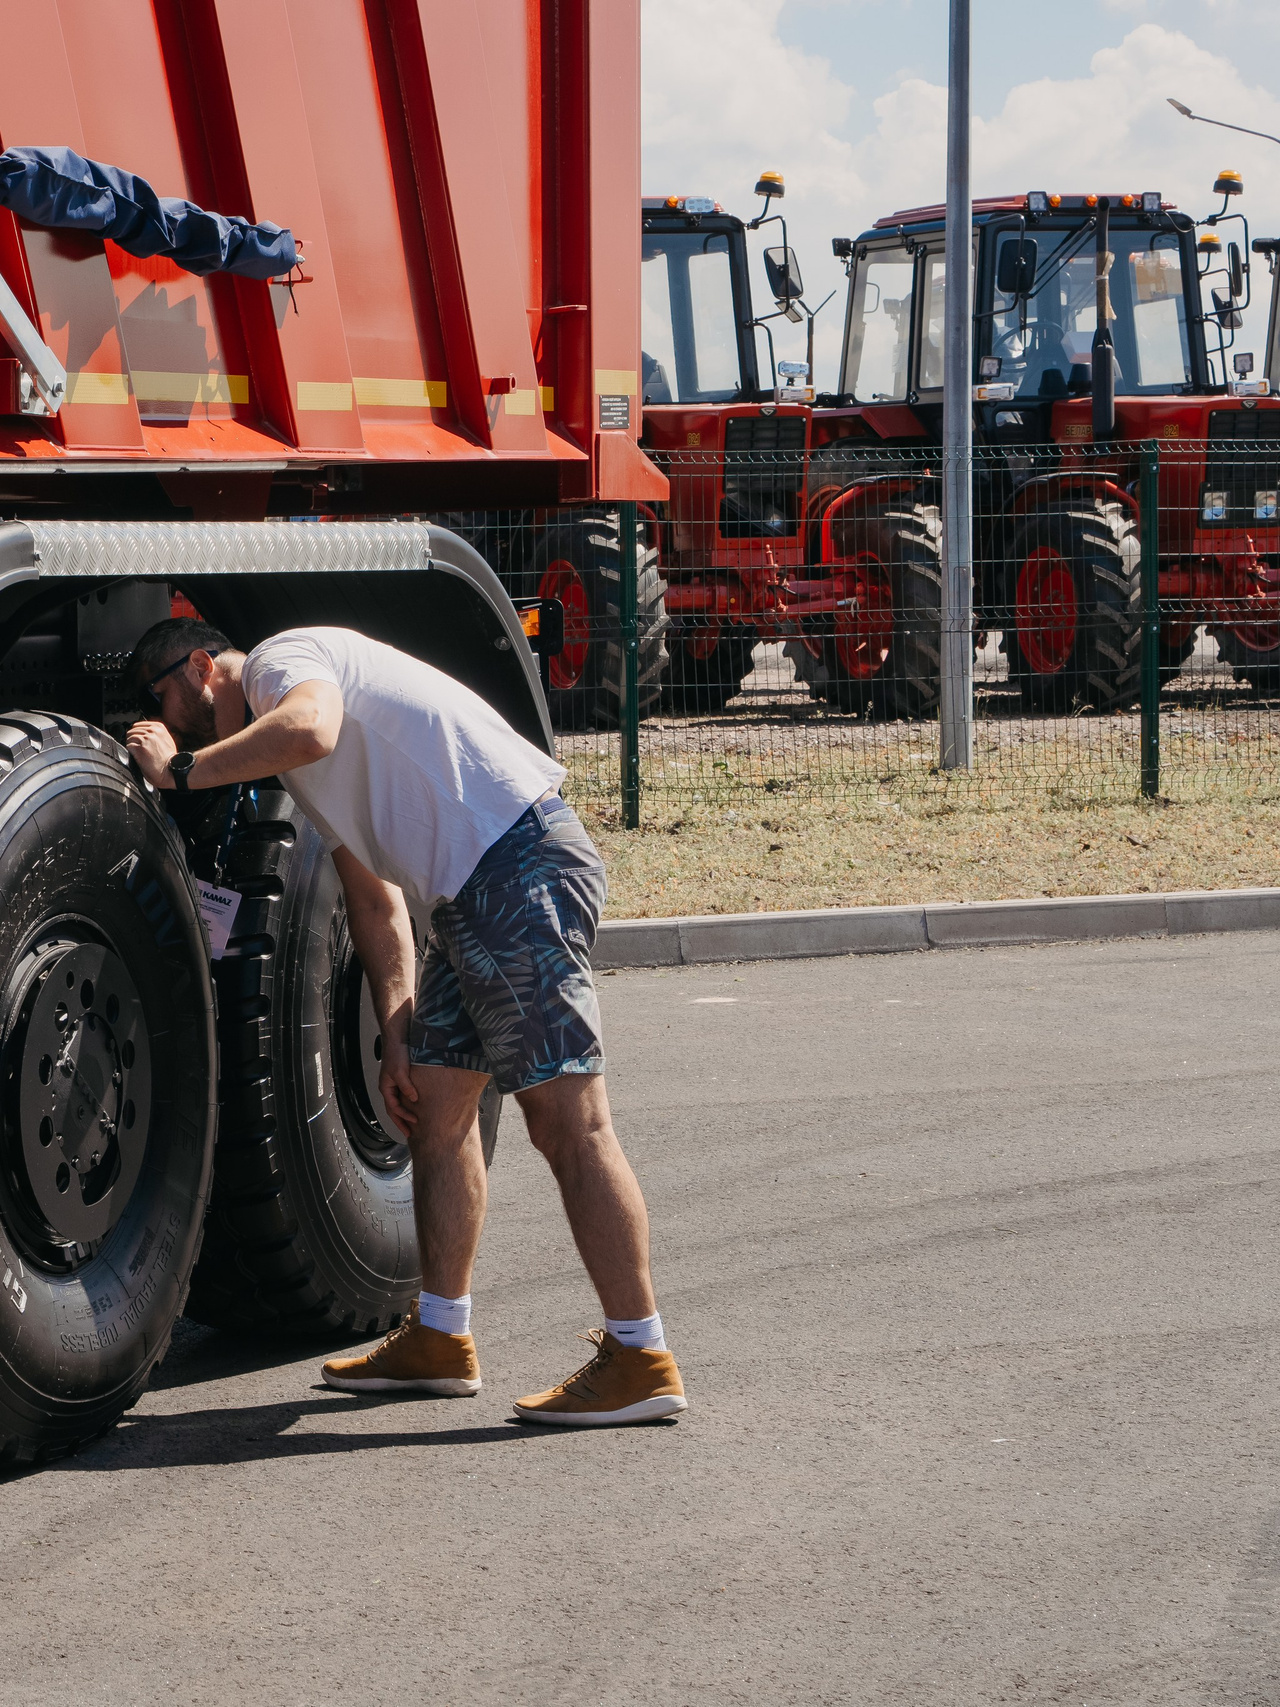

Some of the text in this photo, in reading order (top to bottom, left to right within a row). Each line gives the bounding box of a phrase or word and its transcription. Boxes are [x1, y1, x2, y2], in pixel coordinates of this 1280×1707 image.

[1065, 424, 1093, 437] БЕЛАР
[1163, 424, 1180, 438] 821
[202, 890, 233, 907] KAMAZ
[152, 1212, 181, 1273] STEEL
[119, 1273, 157, 1330] RADIAL
[60, 1322, 122, 1354] TUBELESS
